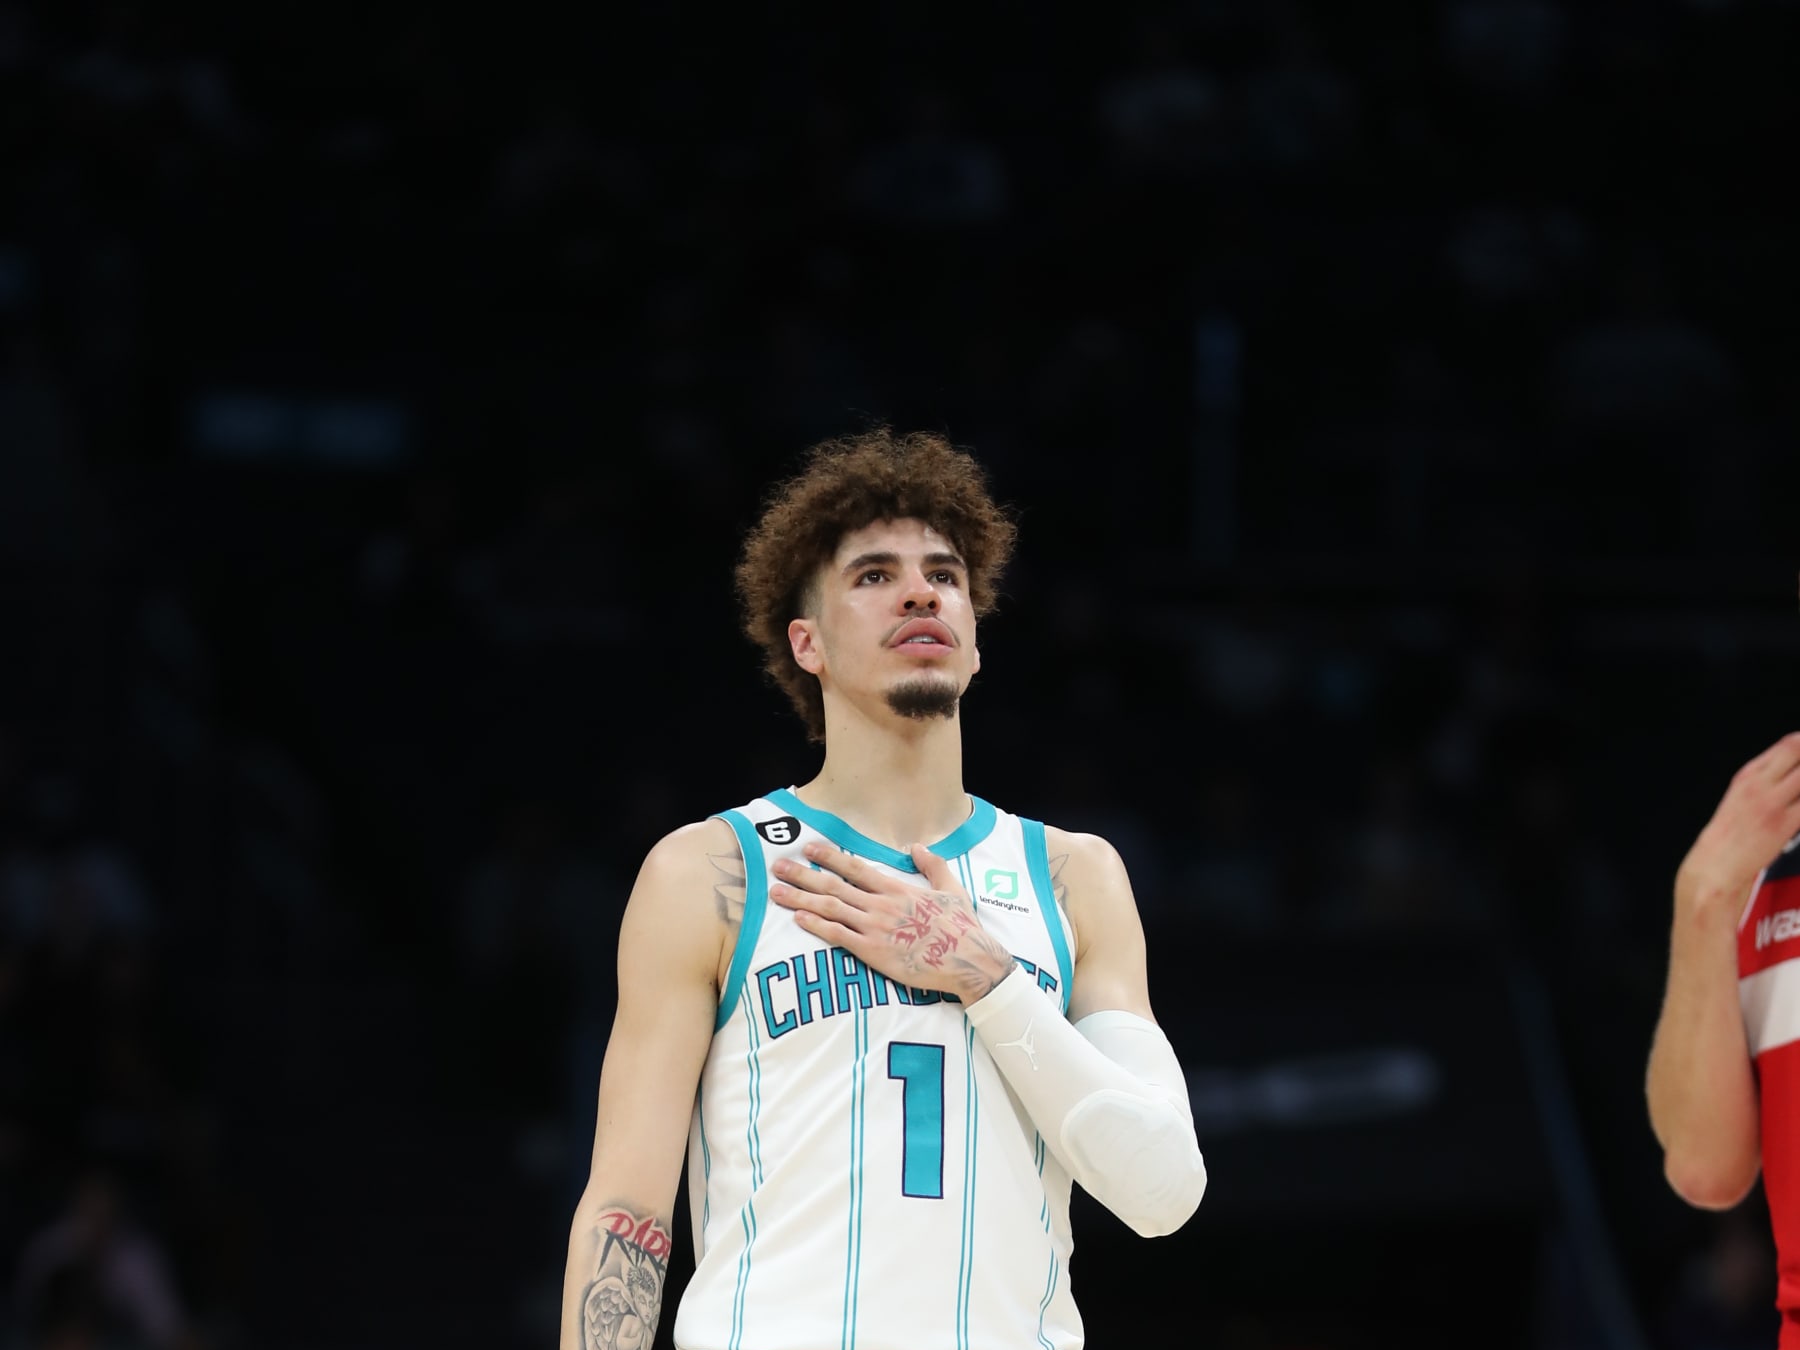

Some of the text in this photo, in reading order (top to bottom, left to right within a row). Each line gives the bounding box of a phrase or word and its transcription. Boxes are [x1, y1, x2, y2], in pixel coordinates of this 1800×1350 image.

[765, 821, 791, 842] 6
[979, 895, 1030, 914] lendingtree
[887, 1041, 945, 1199] 1
